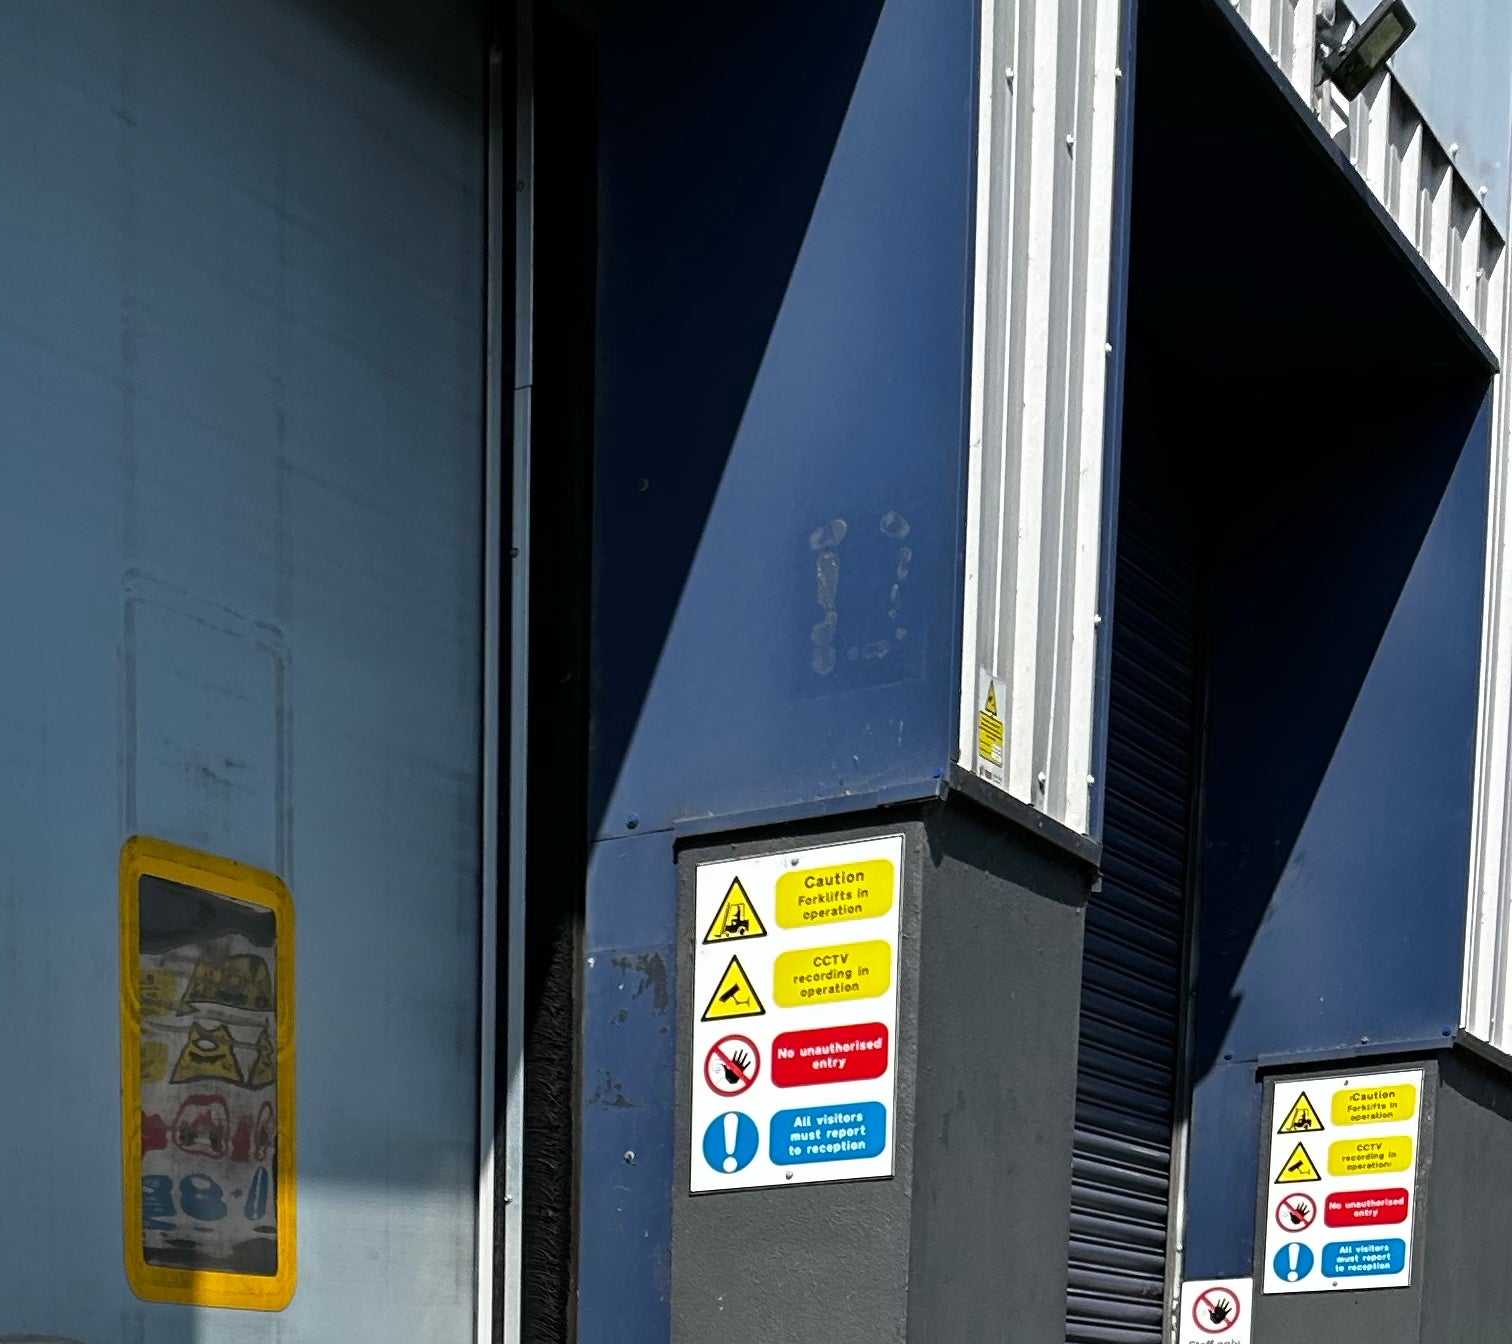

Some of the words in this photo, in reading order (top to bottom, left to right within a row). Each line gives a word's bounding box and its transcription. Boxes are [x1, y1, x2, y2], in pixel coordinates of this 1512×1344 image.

[804, 871, 865, 889] Caution
[797, 890, 853, 906] Forklifts
[857, 888, 869, 899] in
[802, 904, 863, 920] operation
[813, 953, 849, 967] CCTV
[793, 969, 853, 984] recording
[857, 965, 870, 976] in
[799, 982, 860, 998] operation
[777, 1047, 795, 1059] No
[799, 1037, 883, 1057] unauthorised
[811, 1057, 847, 1070] entry
[1351, 1091, 1396, 1101] Caution
[1347, 1102, 1386, 1113] Forklifts
[1389, 1101, 1398, 1109] in
[793, 1115, 812, 1128] All
[816, 1112, 863, 1126] visitors
[1350, 1111, 1394, 1121] operation
[790, 1129, 821, 1142] must
[826, 1124, 866, 1139] report
[788, 1145, 802, 1156] to
[806, 1140, 866, 1154] reception
[1356, 1142, 1383, 1152] CCTV
[1341, 1153, 1385, 1162] recording
[1388, 1151, 1397, 1159] in
[1346, 1161, 1393, 1171] operation
[1328, 1201, 1342, 1211] No
[1344, 1196, 1405, 1209] unauthorised
[1353, 1209, 1379, 1218] entry
[1339, 1245, 1353, 1254] All
[1355, 1244, 1390, 1253] visitors
[1336, 1254, 1359, 1264] must
[1362, 1252, 1391, 1262] report
[1334, 1264, 1345, 1273] to
[1347, 1262, 1391, 1272] reception
